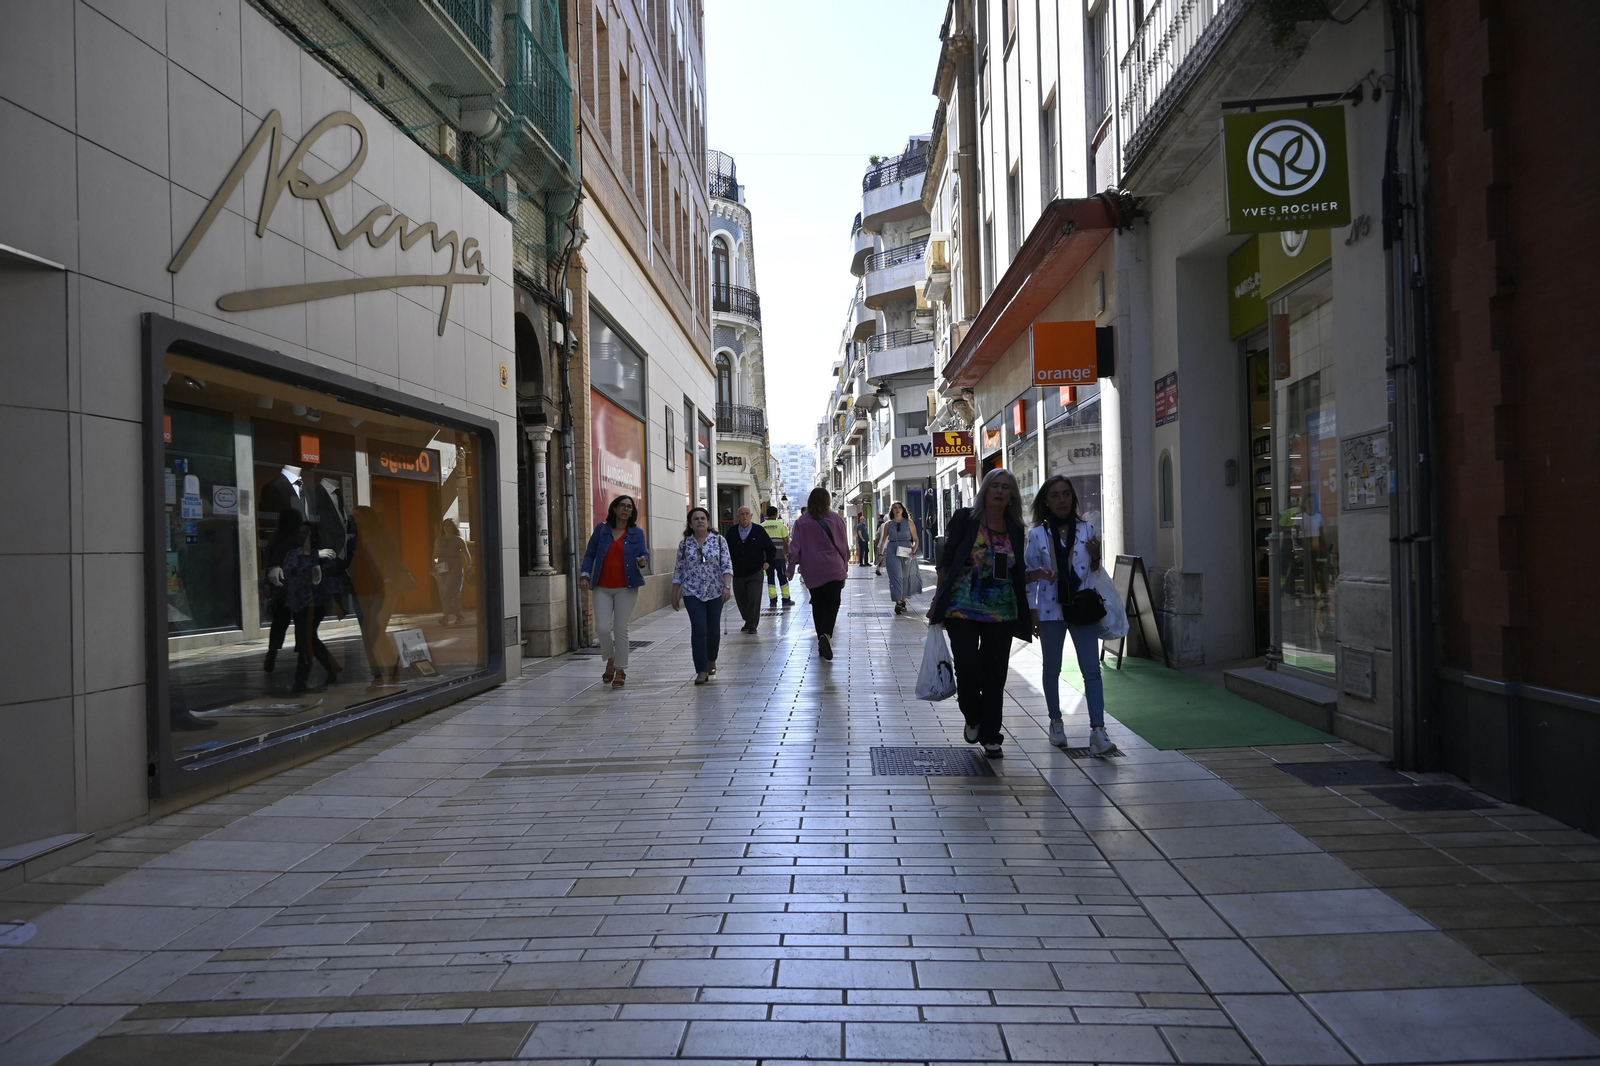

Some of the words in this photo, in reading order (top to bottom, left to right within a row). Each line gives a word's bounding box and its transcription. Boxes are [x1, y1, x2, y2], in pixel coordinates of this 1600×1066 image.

[1242, 206, 1276, 217] YVES
[1281, 201, 1338, 214] ROCHER
[1269, 213, 1313, 222] FRANCE
[1037, 367, 1091, 382] orange
[935, 445, 972, 454] TABACOS
[716, 451, 743, 466] Sfera
